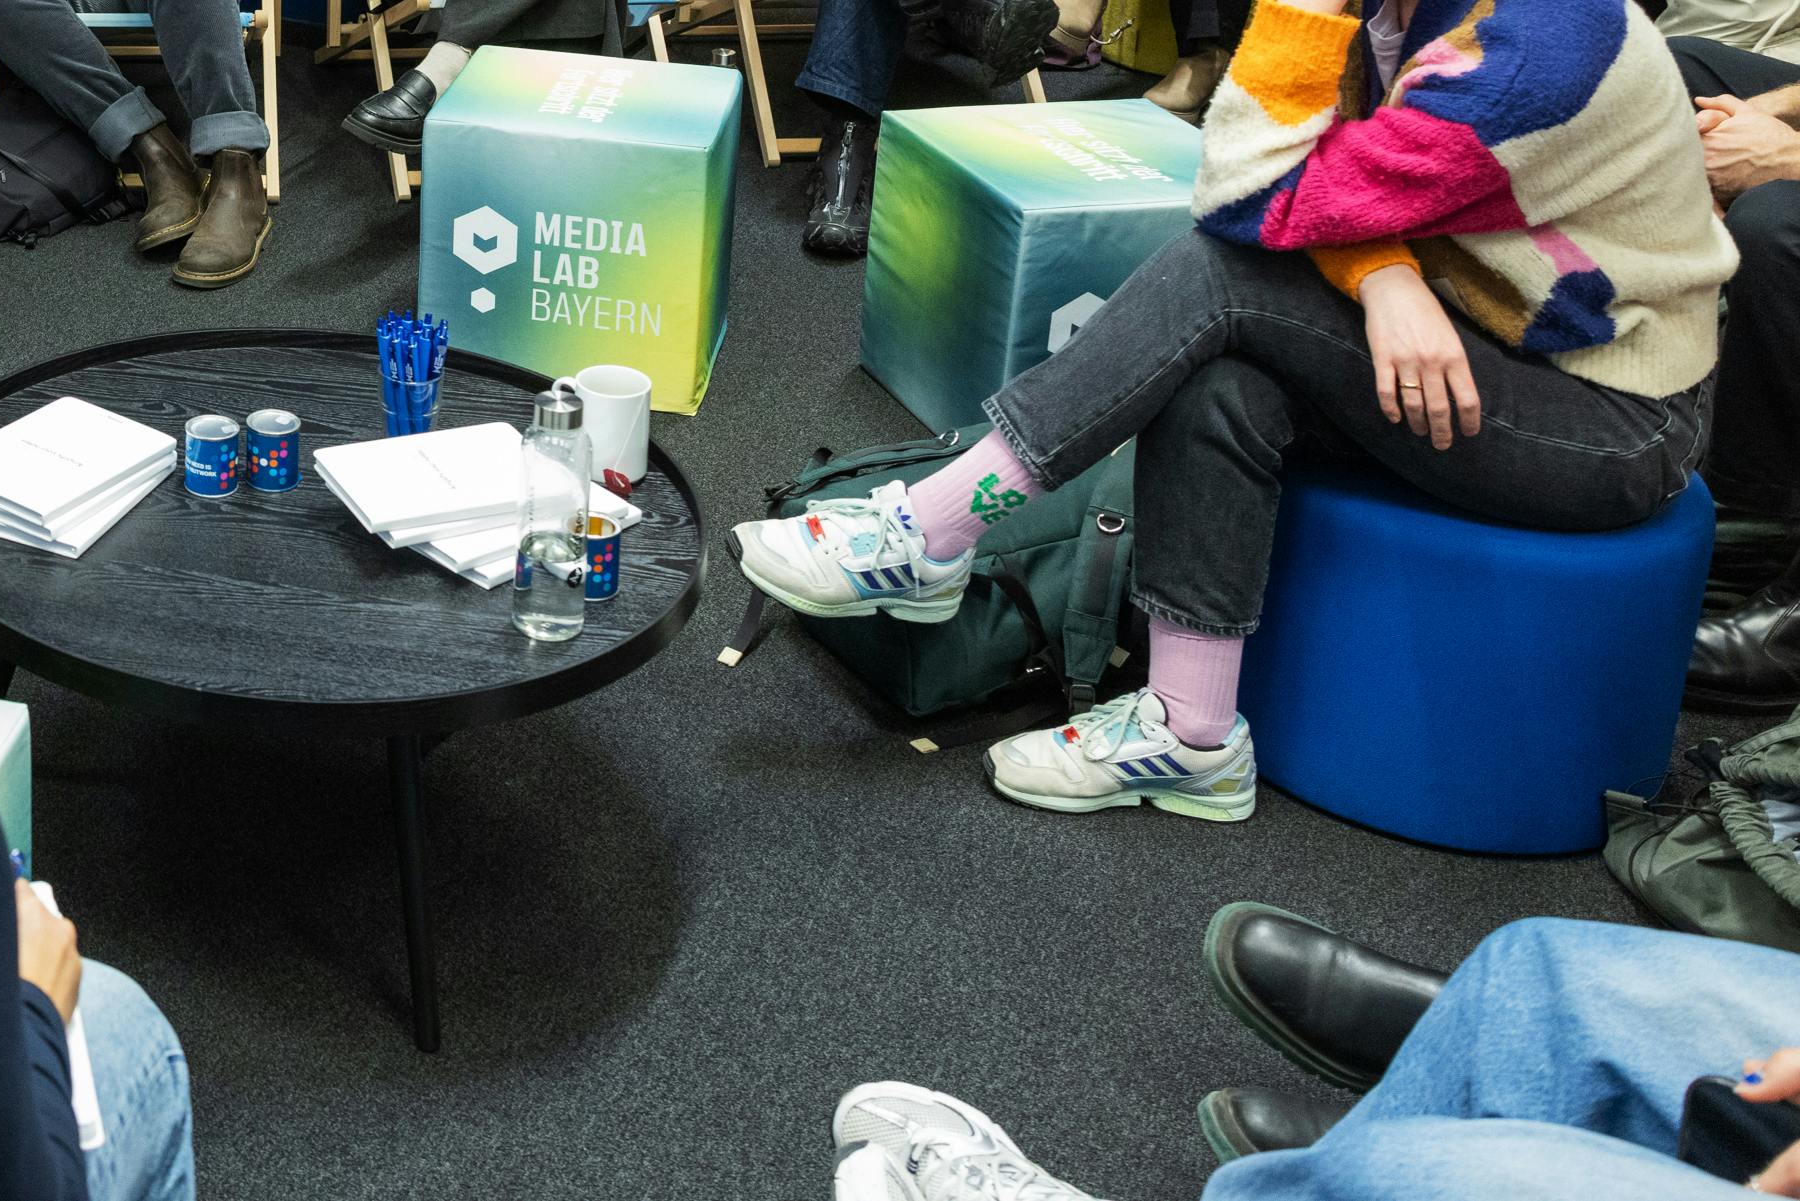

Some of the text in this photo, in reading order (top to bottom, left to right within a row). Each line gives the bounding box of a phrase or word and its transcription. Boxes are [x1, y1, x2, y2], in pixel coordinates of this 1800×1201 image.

[534, 211, 647, 258] MEDIA
[533, 250, 599, 290] LAB
[531, 287, 662, 337] BAYERN
